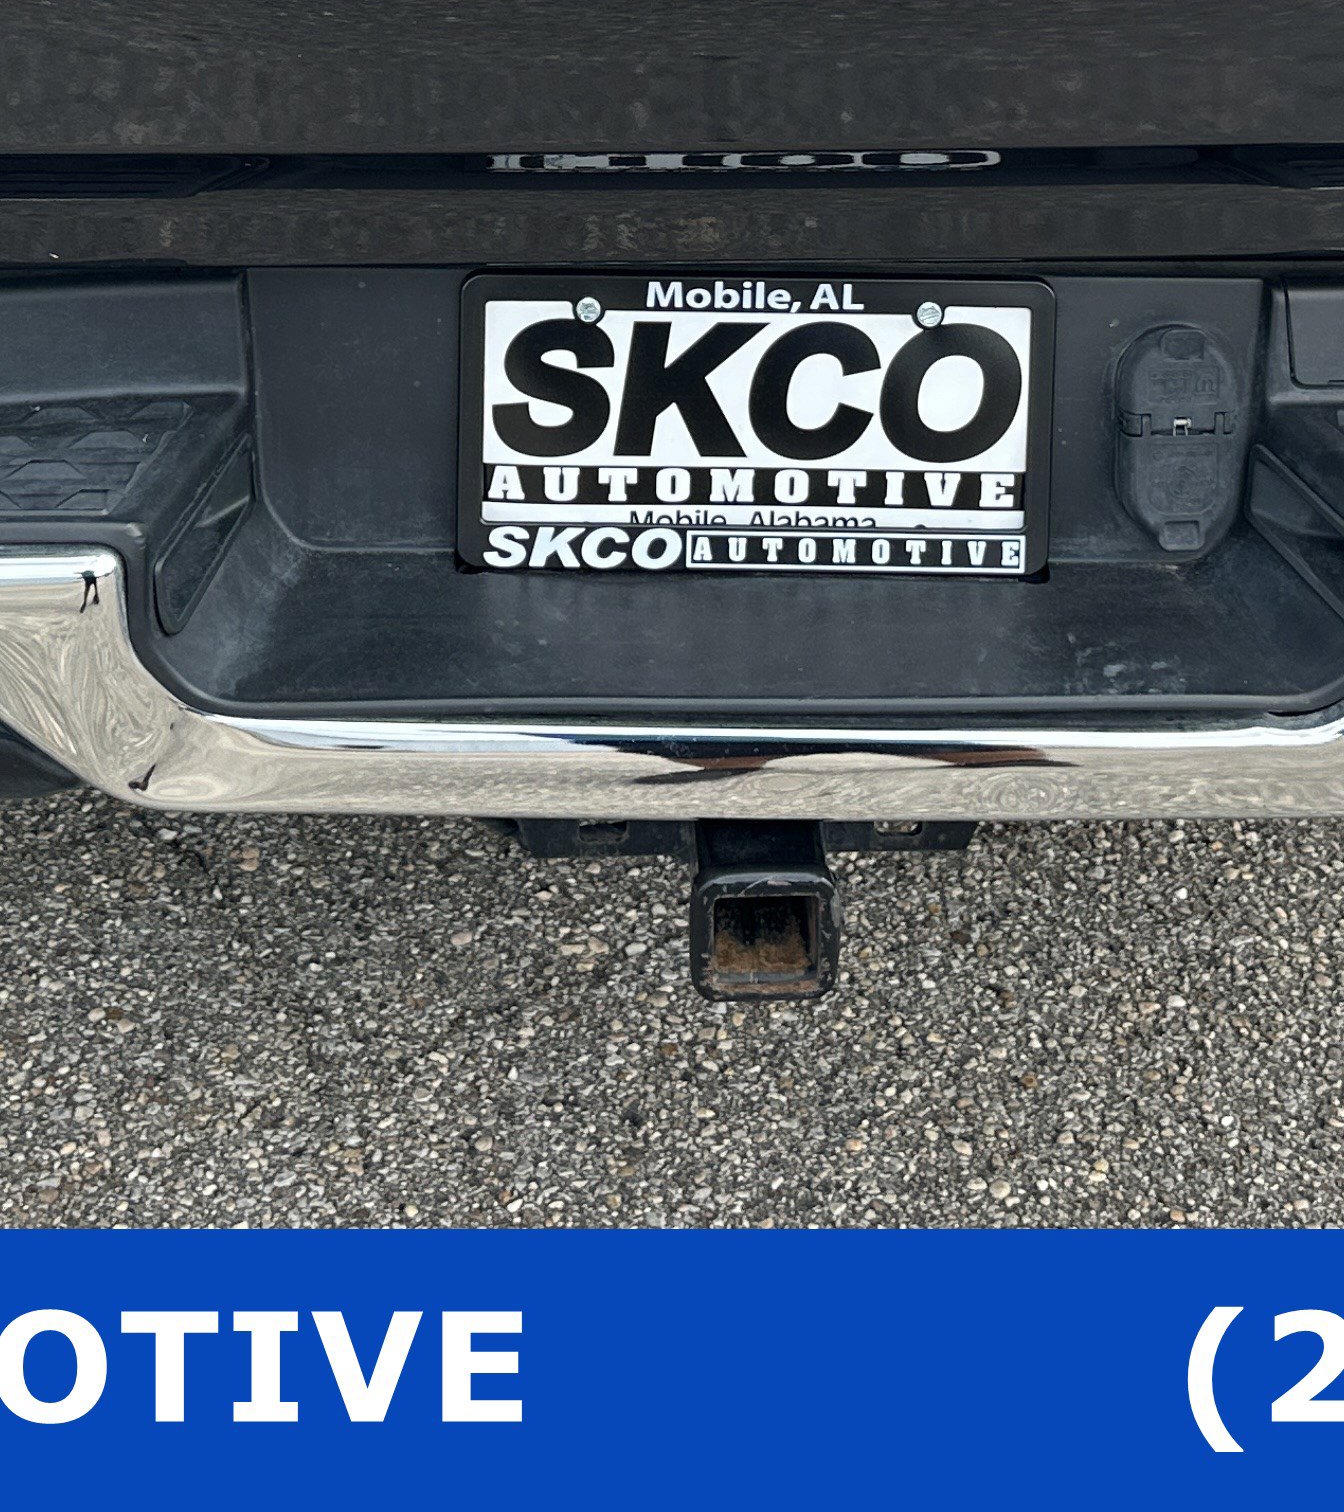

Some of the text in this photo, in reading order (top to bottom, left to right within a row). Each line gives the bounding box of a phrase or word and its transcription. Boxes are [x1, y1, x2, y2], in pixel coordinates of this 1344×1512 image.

[646, 282, 865, 313] Mobile, AL
[491, 318, 1022, 464] SKCO
[488, 465, 1016, 509] AUTOMOTIVE
[483, 526, 1021, 569] SKCO AUTOMOTIVE
